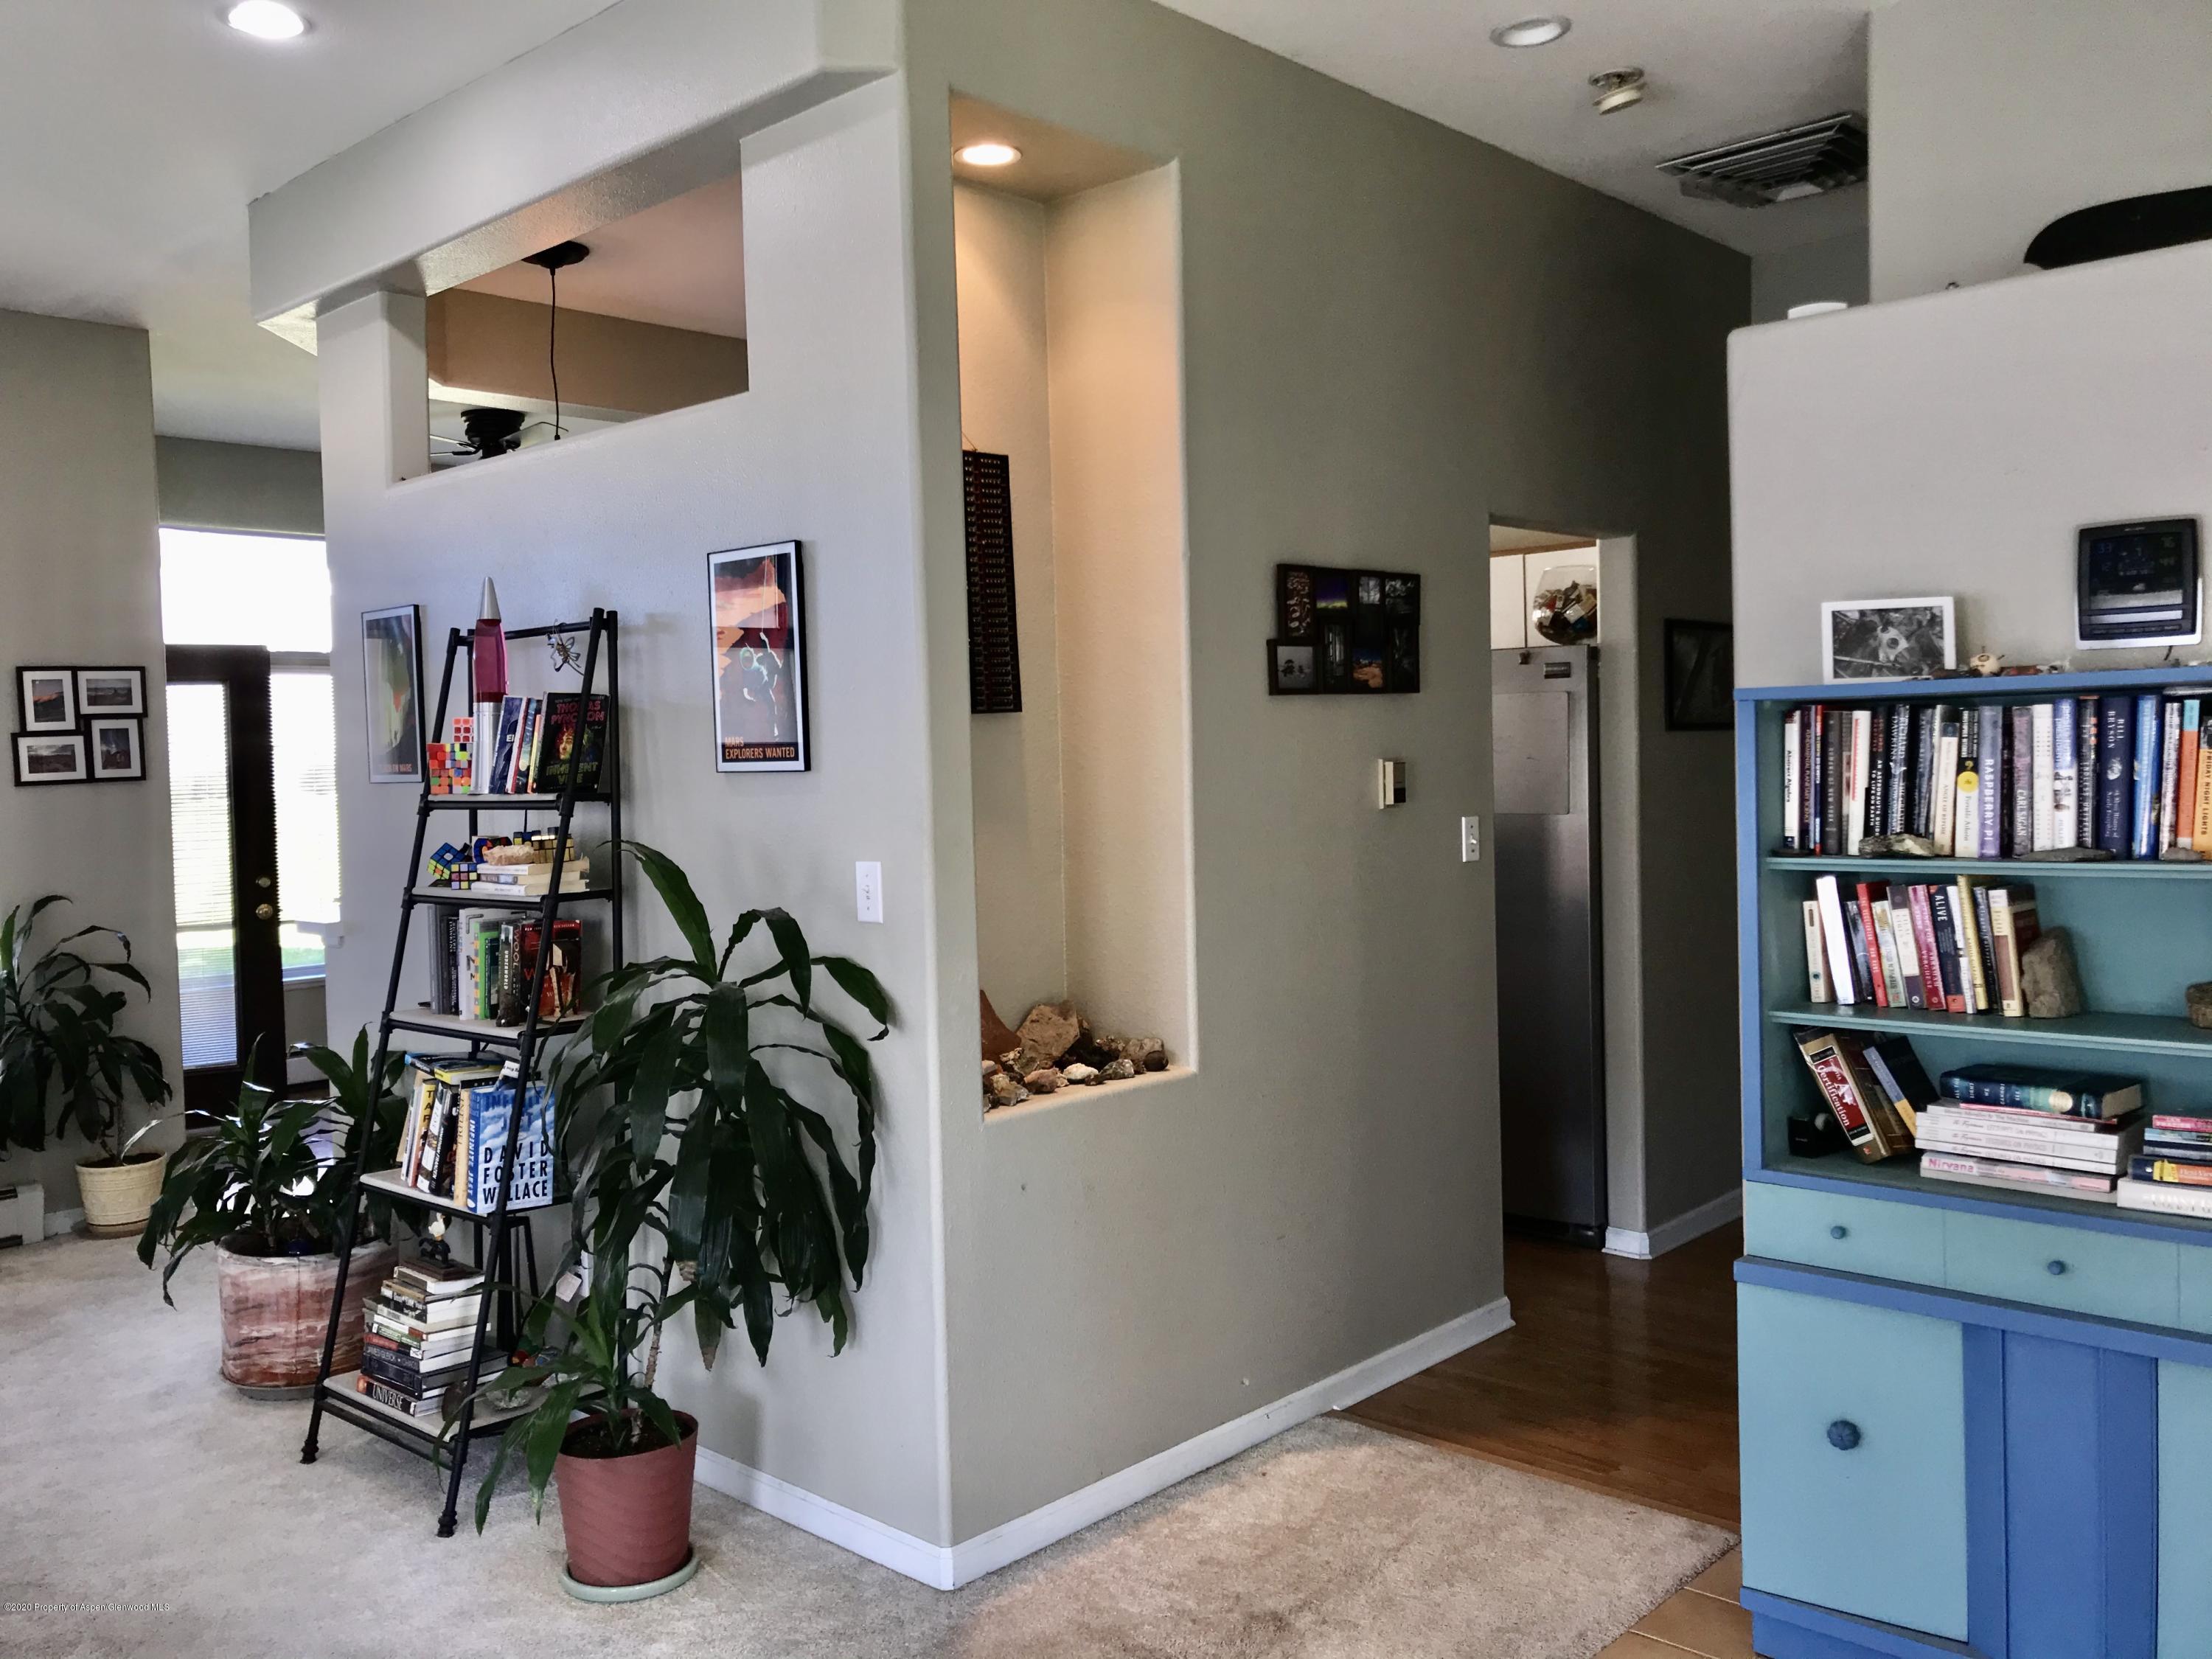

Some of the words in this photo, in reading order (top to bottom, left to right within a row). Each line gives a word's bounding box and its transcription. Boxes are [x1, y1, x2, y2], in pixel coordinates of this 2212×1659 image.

[551, 712, 605, 724] PYNCON
[2107, 711, 2115, 748] BRYSON
[725, 737, 744, 747] MARS
[726, 748, 763, 759] EXPLORERS
[765, 747, 795, 758] WANTED
[546, 762, 598, 776] INHEENT
[1877, 760, 1882, 769] AN
[1871, 796, 1875, 804] ON
[1984, 759, 1994, 825] RASPBERRY
[2017, 790, 2026, 810] CARL
[1984, 830, 1994, 840] PI
[2017, 811, 2026, 836] SAGAN
[1934, 894, 1948, 922] ALIVE
[1978, 905, 1988, 933] Elegant
[1863, 910, 1873, 941] VEGETARIAN
[1982, 935, 1992, 967] Universe
[1886, 963, 1898, 990] STEPHEN
[1921, 950, 1933, 990] VERGHESE
[1816, 1063, 1852, 1127] Certification
[1833, 1077, 1858, 1108] A+
[1984, 1088, 1989, 1096] WE
[467, 1119, 476, 1166] INFINITE
[1928, 1158, 1975, 1173] Nirvana
[483, 1180, 548, 1204] WLLACE
[373, 1384, 403, 1410] UNIVERSE
